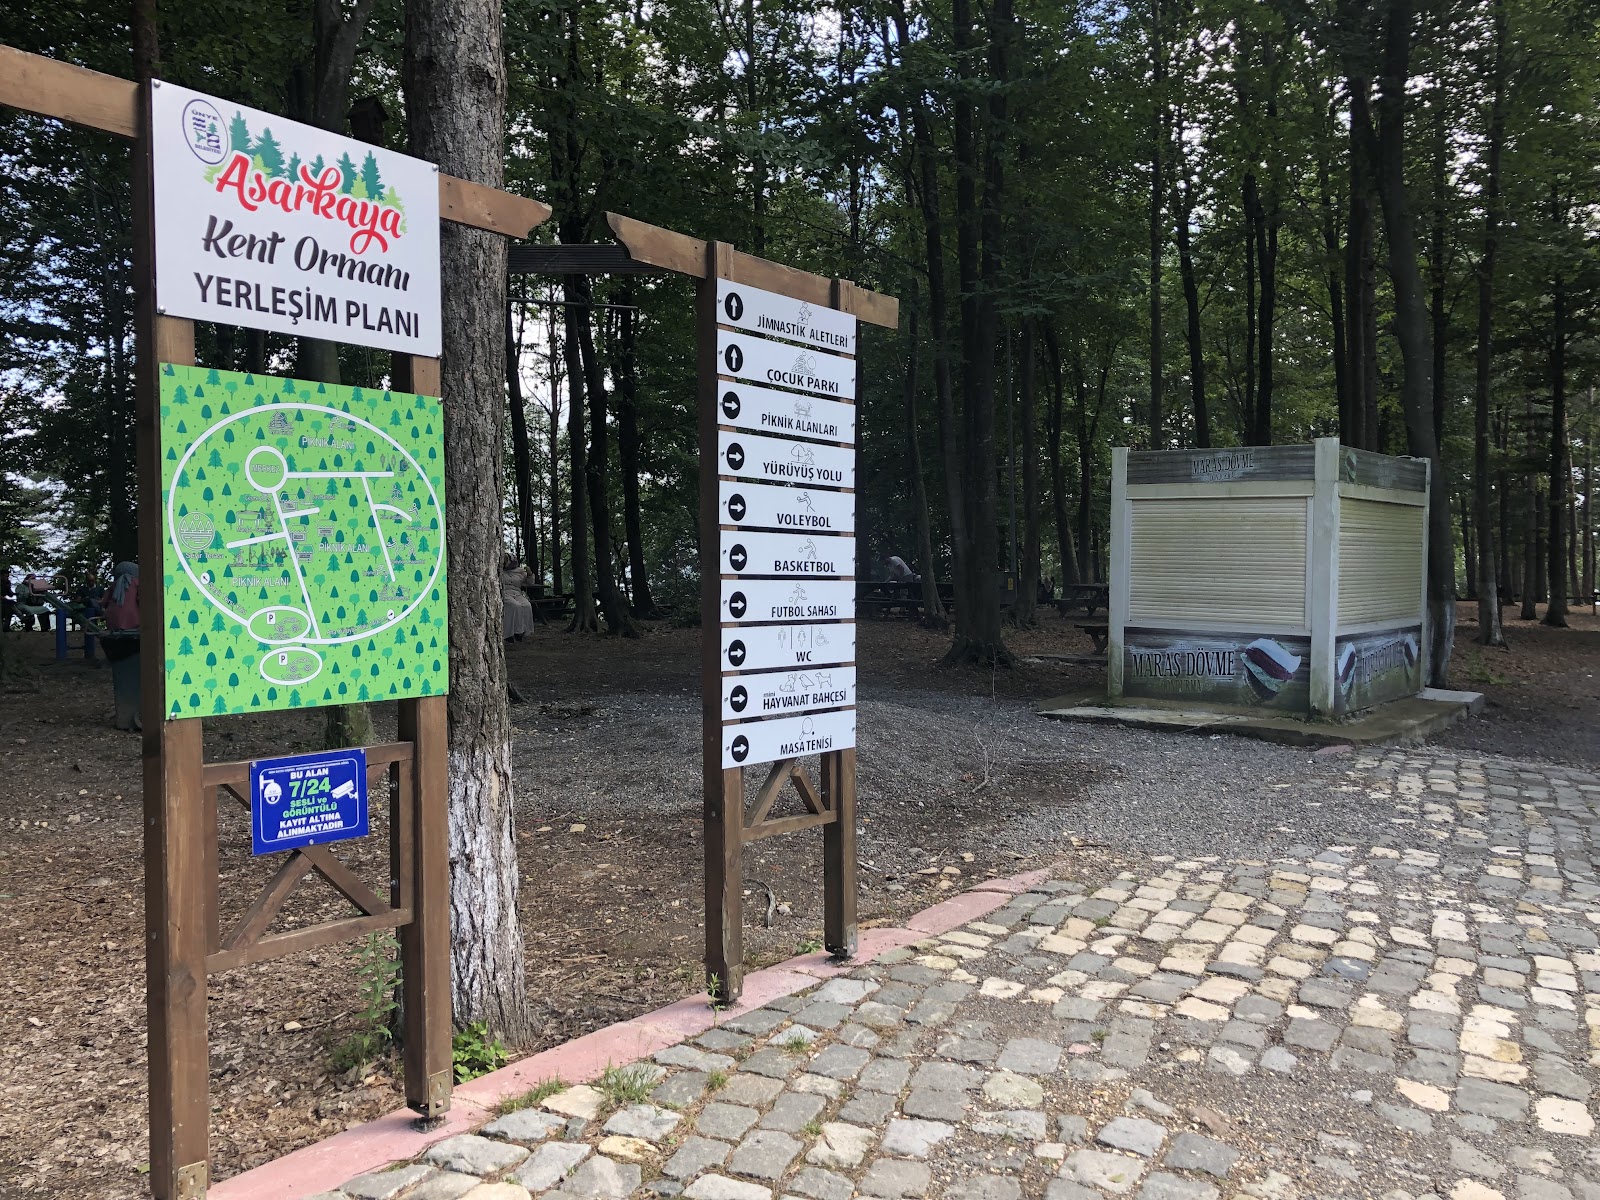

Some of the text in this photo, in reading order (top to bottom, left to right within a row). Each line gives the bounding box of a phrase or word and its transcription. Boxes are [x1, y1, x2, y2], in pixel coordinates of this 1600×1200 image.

[215, 153, 402, 254] Asarkaya
[201, 214, 410, 291] Kent Ormanı
[193, 271, 419, 339] YERLEŞİM PLANI
[757, 314, 848, 348] JİMNASTİK ALETLERİ
[767, 369, 838, 393] ÇOCUK PARKI
[762, 412, 837, 436] PİKNİK ALANLARI
[331, 441, 355, 449] ALANI
[763, 461, 841, 481] YÜRÜYÜŞ YOLU
[777, 513, 831, 527] VOLEYBOL
[348, 544, 370, 553] ALANI
[775, 561, 835, 572] BASKETBOL
[232, 575, 289, 586] PİKNİK ALANI
[772, 606, 836, 617] FUTBOL SAHASI
[796, 651, 811, 662] WC
[1187, 648, 1234, 676] DÖVME
[763, 688, 846, 710] HAYVANAT BAHÇESİ
[780, 736, 832, 755] MASA TENİSİ
[291, 768, 328, 779] BU ALAN
[289, 777, 331, 798] 7/24
[283, 802, 337, 818] GÖRÜNTÜLÜ
[290, 796, 315, 807] SESLİ
[280, 812, 340, 828] KAYIT ALTINA
[277, 821, 343, 838] ALINMAKTADIR
